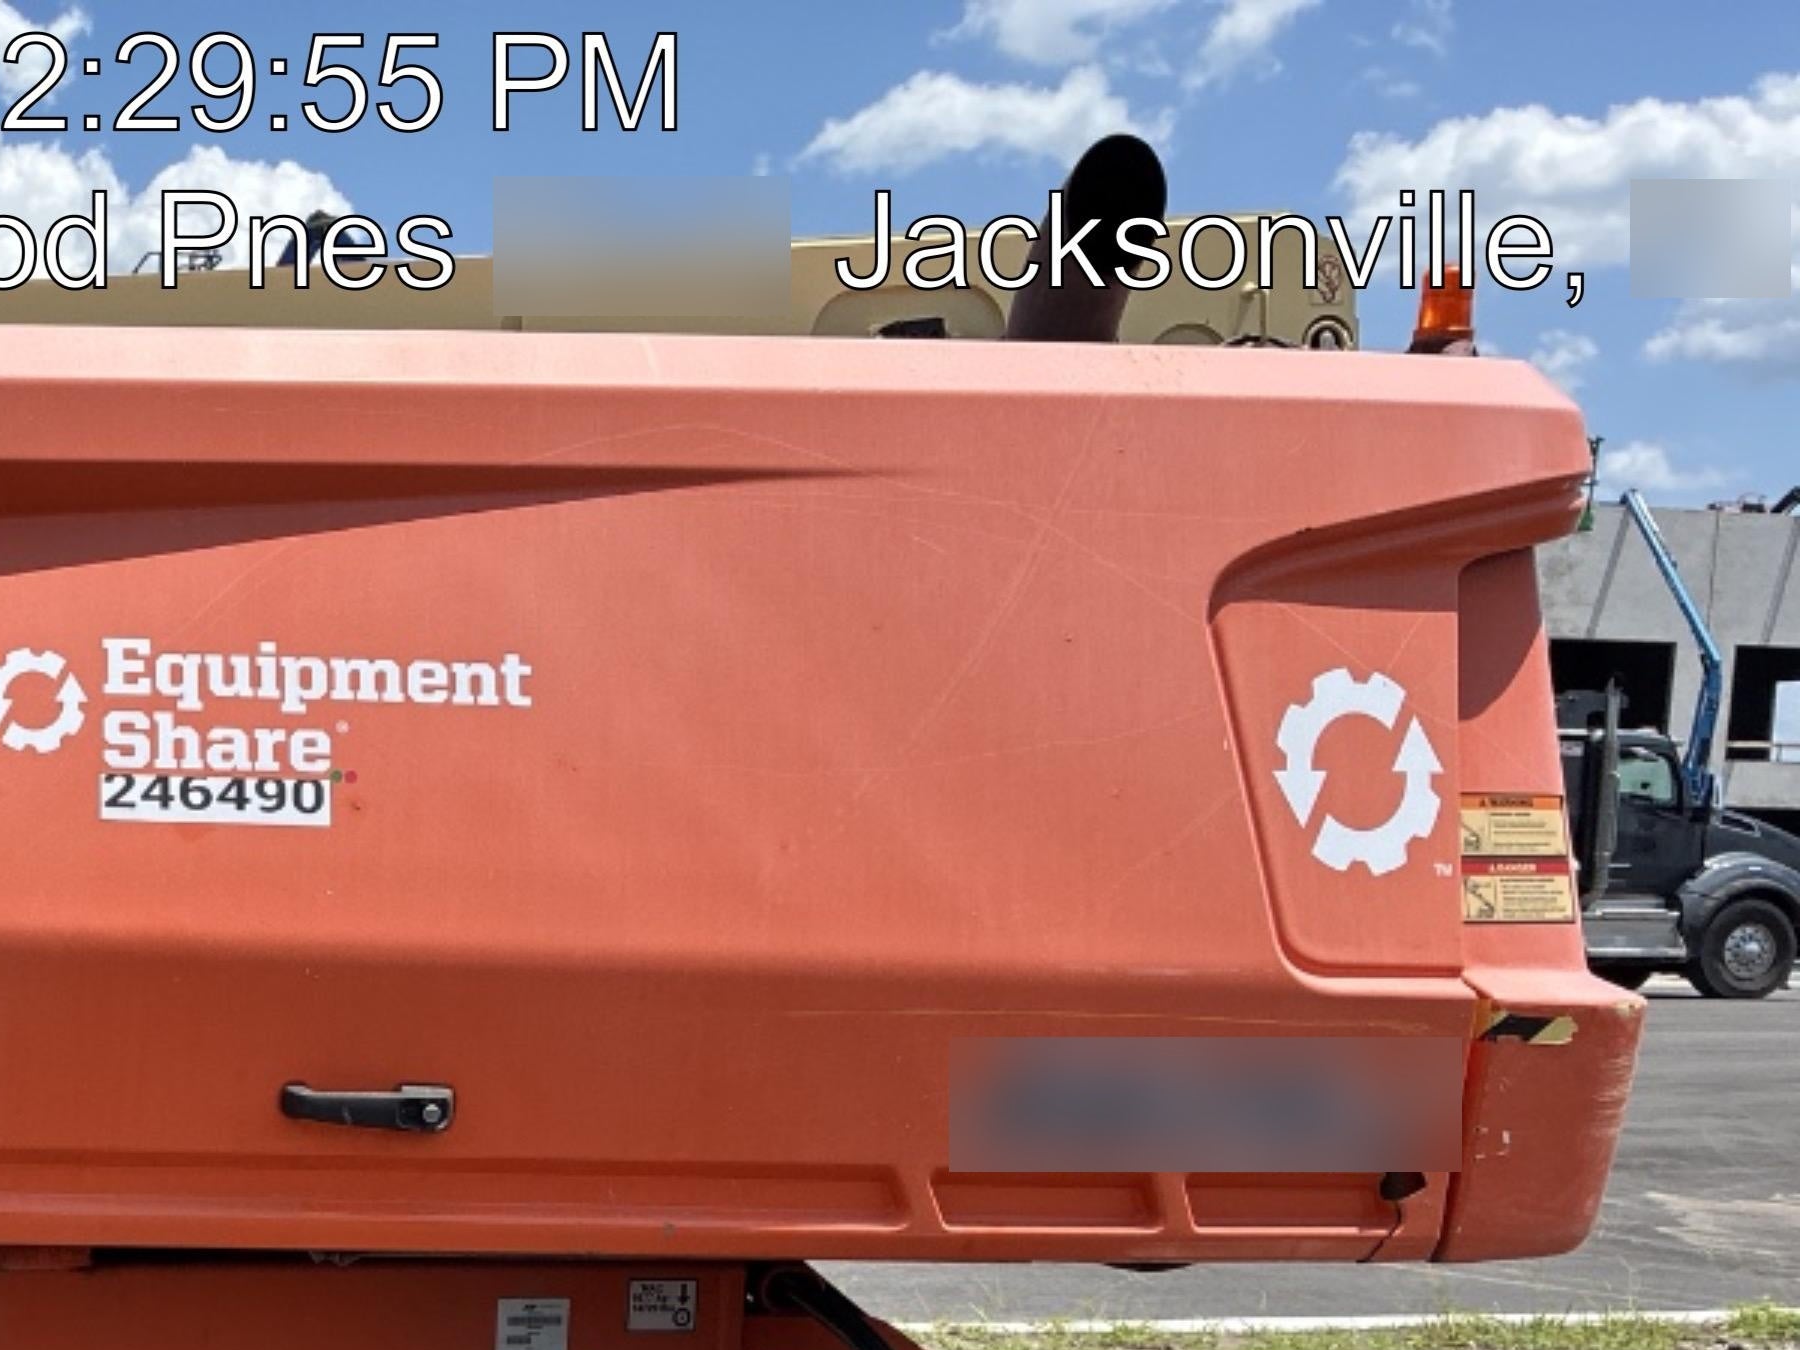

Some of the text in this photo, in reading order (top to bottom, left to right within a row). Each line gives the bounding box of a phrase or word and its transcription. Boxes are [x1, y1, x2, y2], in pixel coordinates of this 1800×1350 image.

[102, 638, 532, 714] Equipment
[102, 710, 331, 772] Share
[103, 773, 325, 814] 246490
